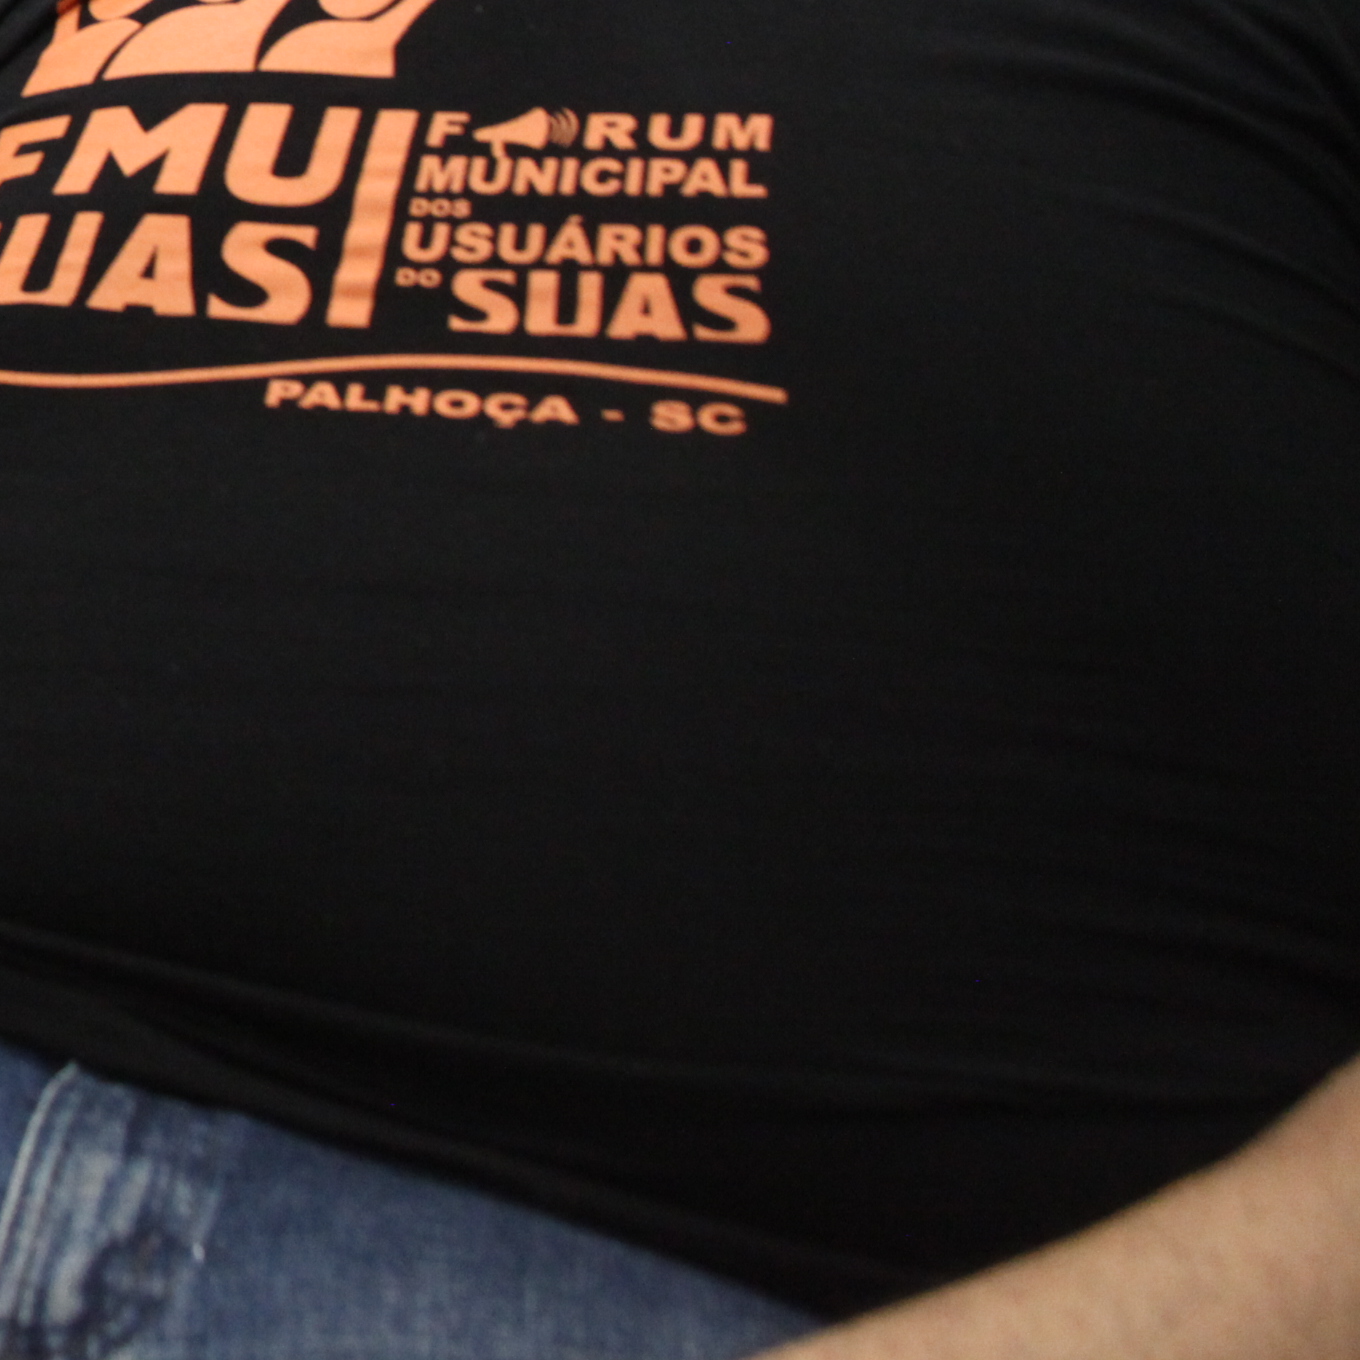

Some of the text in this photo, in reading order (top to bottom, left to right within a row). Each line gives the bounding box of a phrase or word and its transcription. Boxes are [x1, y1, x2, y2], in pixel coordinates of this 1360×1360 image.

[414, 153, 770, 199] MUNICIPAL
[408, 196, 472, 219] DOS
[401, 216, 770, 270] USUÁRIOS
[394, 266, 443, 289] DO
[448, 268, 772, 344] SUAS
[264, 377, 580, 429] PALHOÇA
[650, 399, 748, 436] SC
